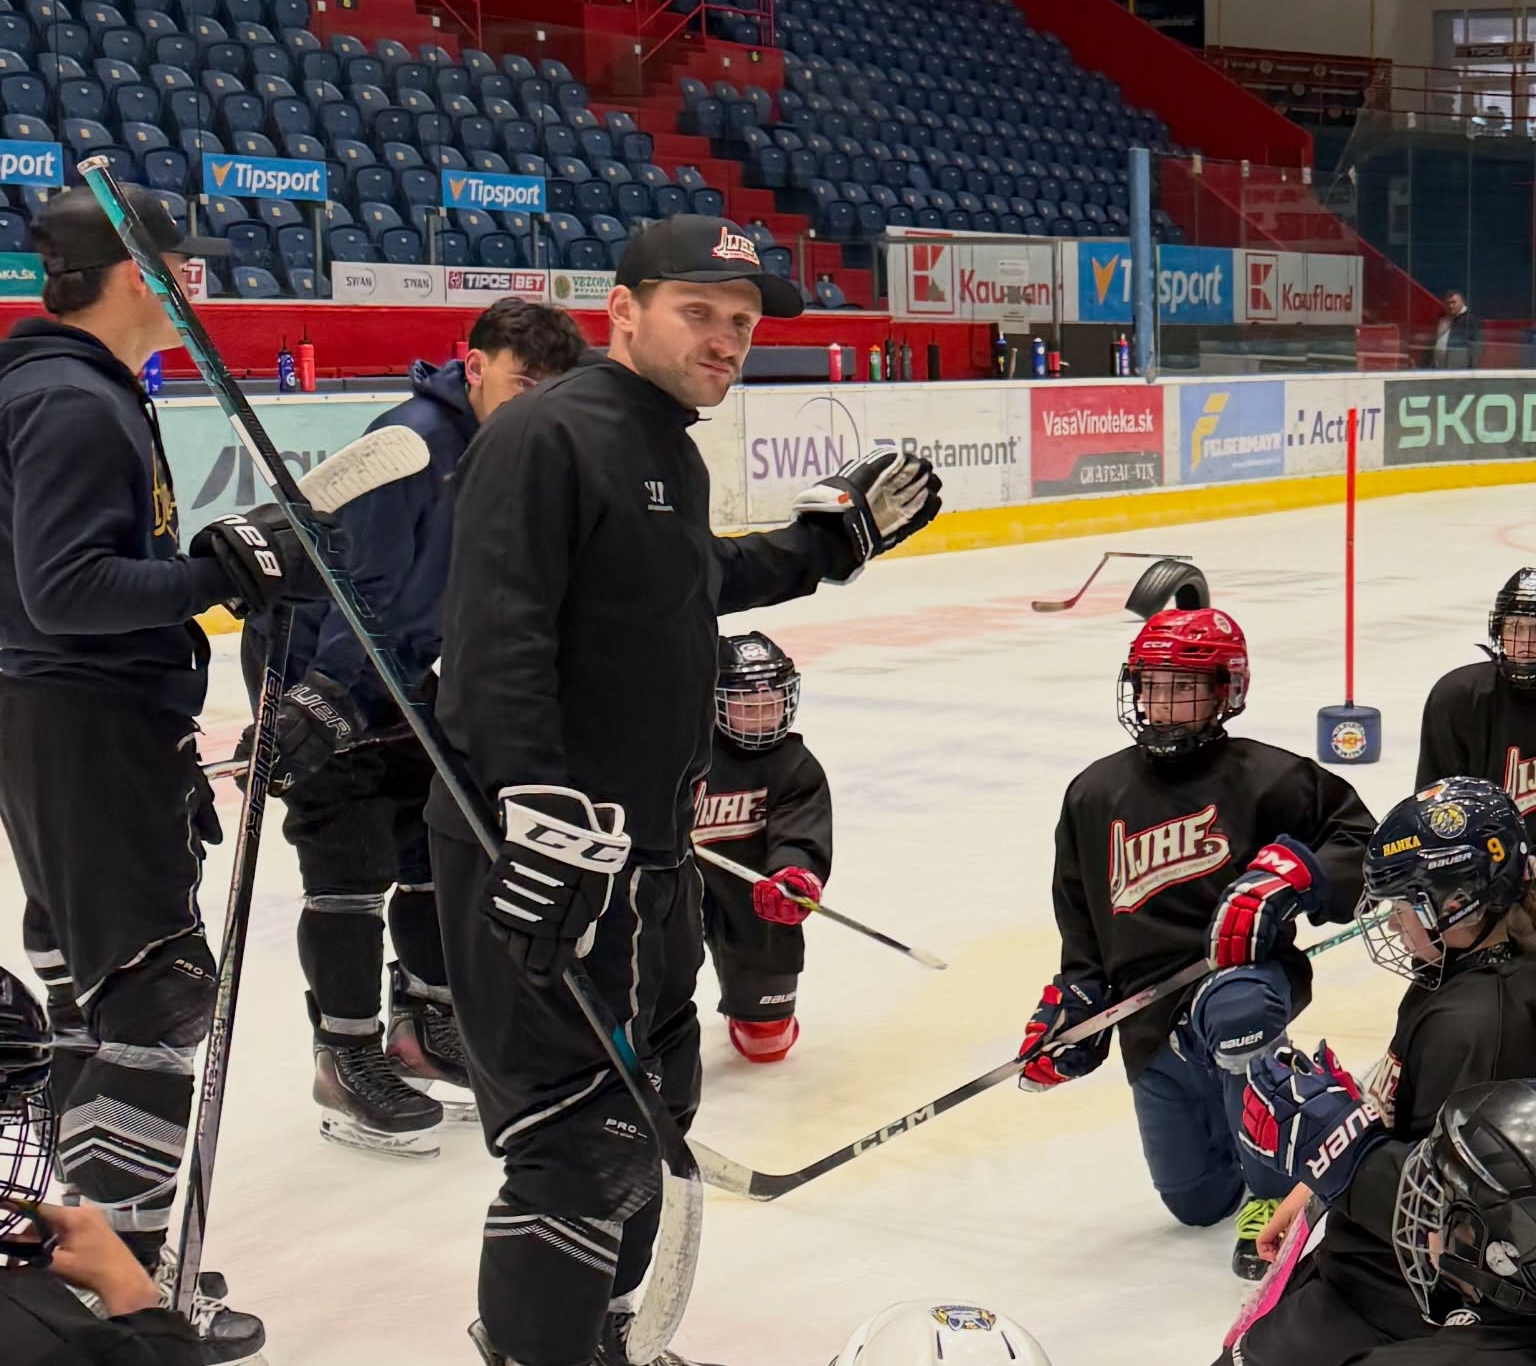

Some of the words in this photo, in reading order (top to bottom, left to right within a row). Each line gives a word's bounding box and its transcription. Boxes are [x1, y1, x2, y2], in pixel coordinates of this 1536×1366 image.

[0, 151, 55, 184] port
[235, 163, 320, 194] Tipsport
[468, 179, 540, 208] Tipsport
[465, 273, 512, 289] TIPOS
[514, 274, 546, 291] BET
[1120, 258, 1223, 314] Tsport
[1281, 282, 1354, 313] Kaufland
[752, 434, 846, 480] SWAN
[523, 821, 629, 865] CC
[1383, 835, 1422, 857] HANKA
[1485, 837, 1506, 864] 9
[1427, 852, 1473, 871] BAUER
[1220, 1030, 1264, 1050] BAUER
[604, 1118, 638, 1134] PRO
[853, 1102, 937, 1156] CCM
